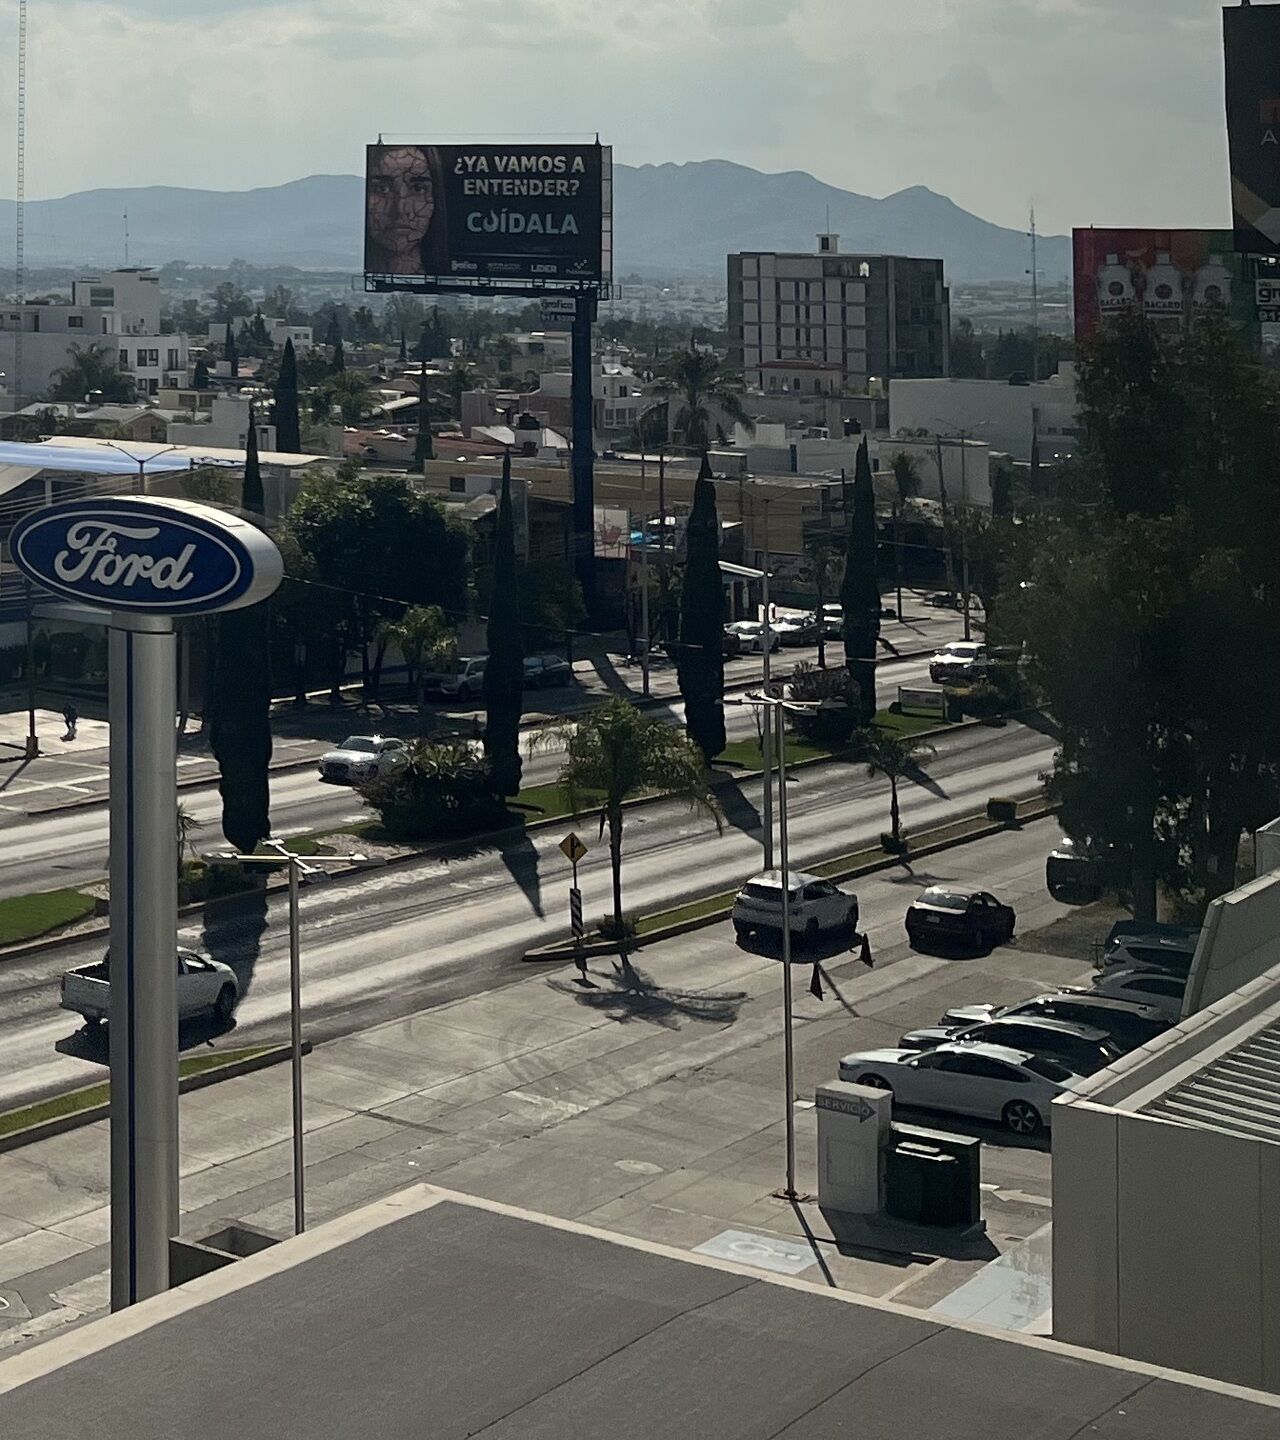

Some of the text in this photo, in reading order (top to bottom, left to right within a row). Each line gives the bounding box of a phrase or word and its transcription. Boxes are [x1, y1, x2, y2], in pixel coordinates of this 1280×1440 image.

[454, 156, 585, 174] ¿YA VAMOS A
[463, 179, 580, 196] ENTENDER?
[54, 520, 197, 591] Ford
[818, 1097, 870, 1116] SERVICIO
